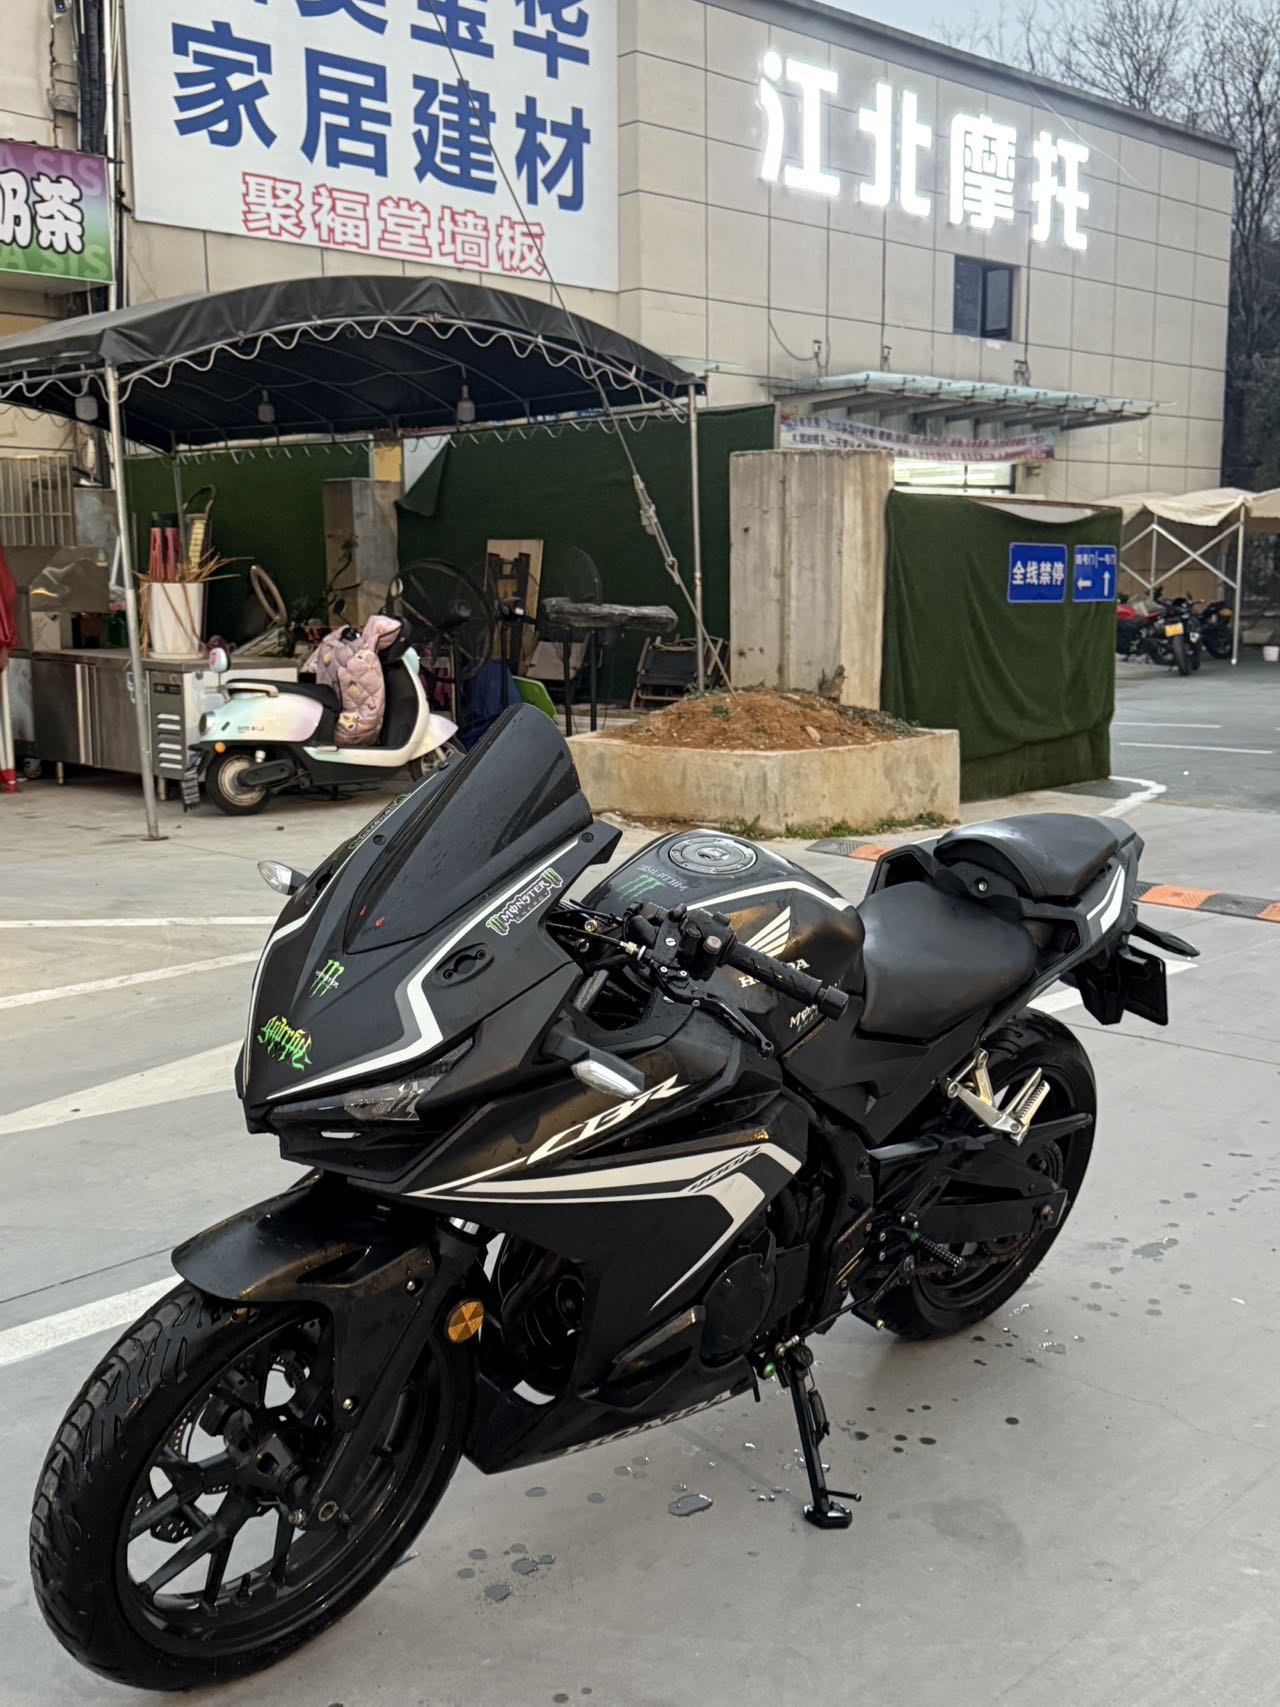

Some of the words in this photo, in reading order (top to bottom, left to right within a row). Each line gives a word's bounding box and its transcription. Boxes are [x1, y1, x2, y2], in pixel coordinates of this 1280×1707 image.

[172, 20, 591, 211] 家居建材
[757, 51, 1090, 251] 江北摩托
[241, 172, 546, 276] 聚福堂墙板
[1012, 560, 1064, 585] 全线禁停
